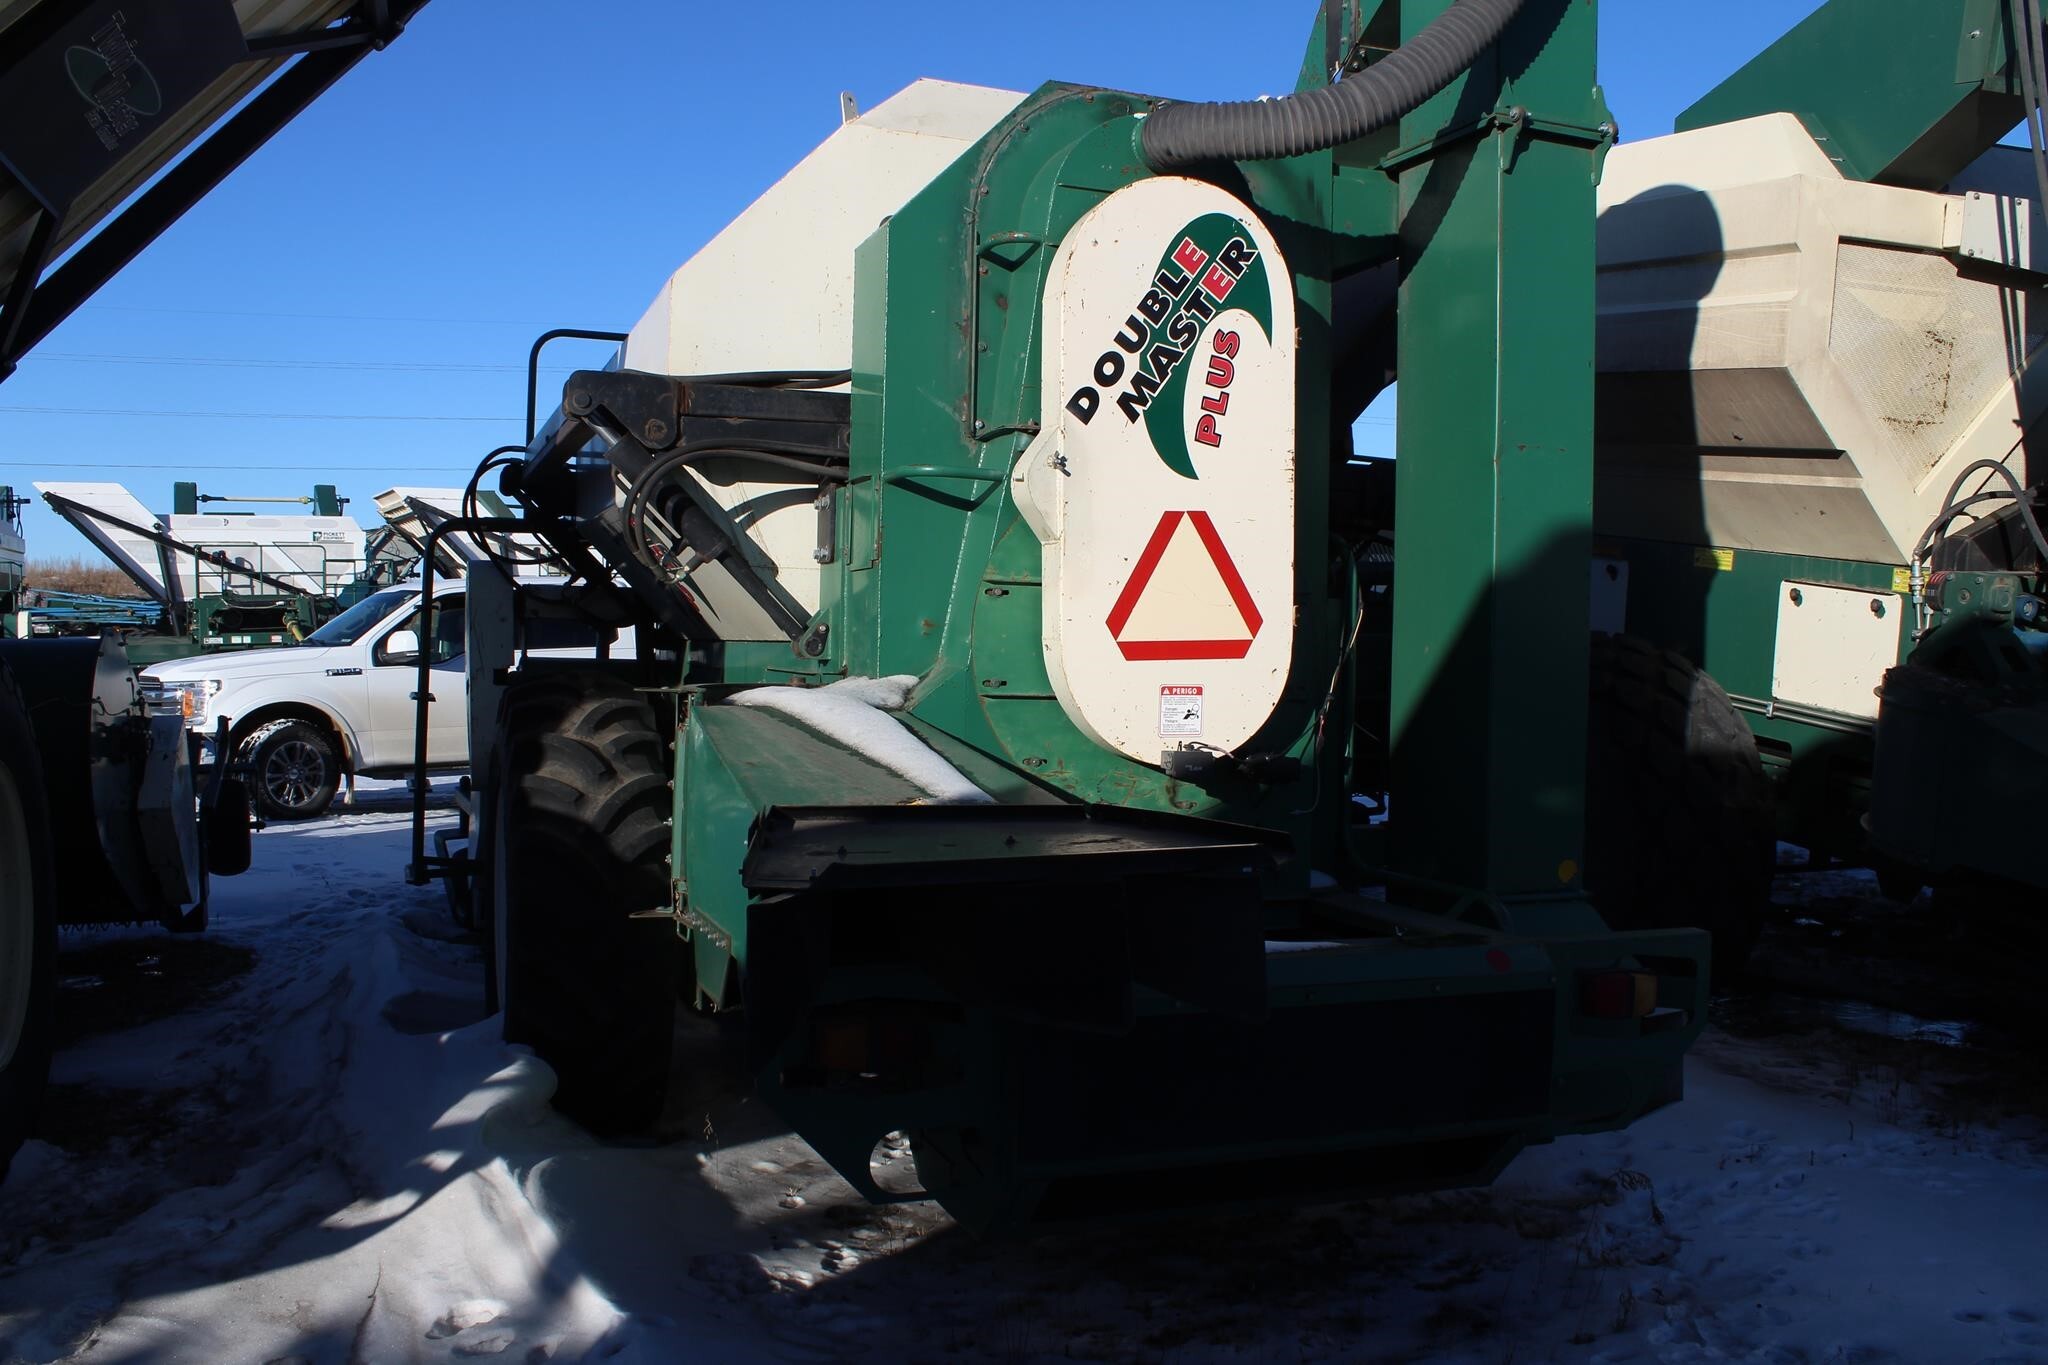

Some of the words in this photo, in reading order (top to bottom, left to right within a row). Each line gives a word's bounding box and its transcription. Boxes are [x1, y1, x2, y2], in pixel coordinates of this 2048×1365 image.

[1065, 236, 1209, 426] DOUBLE
[1116, 236, 1259, 425] MASTER
[1194, 328, 1241, 448] PLUS
